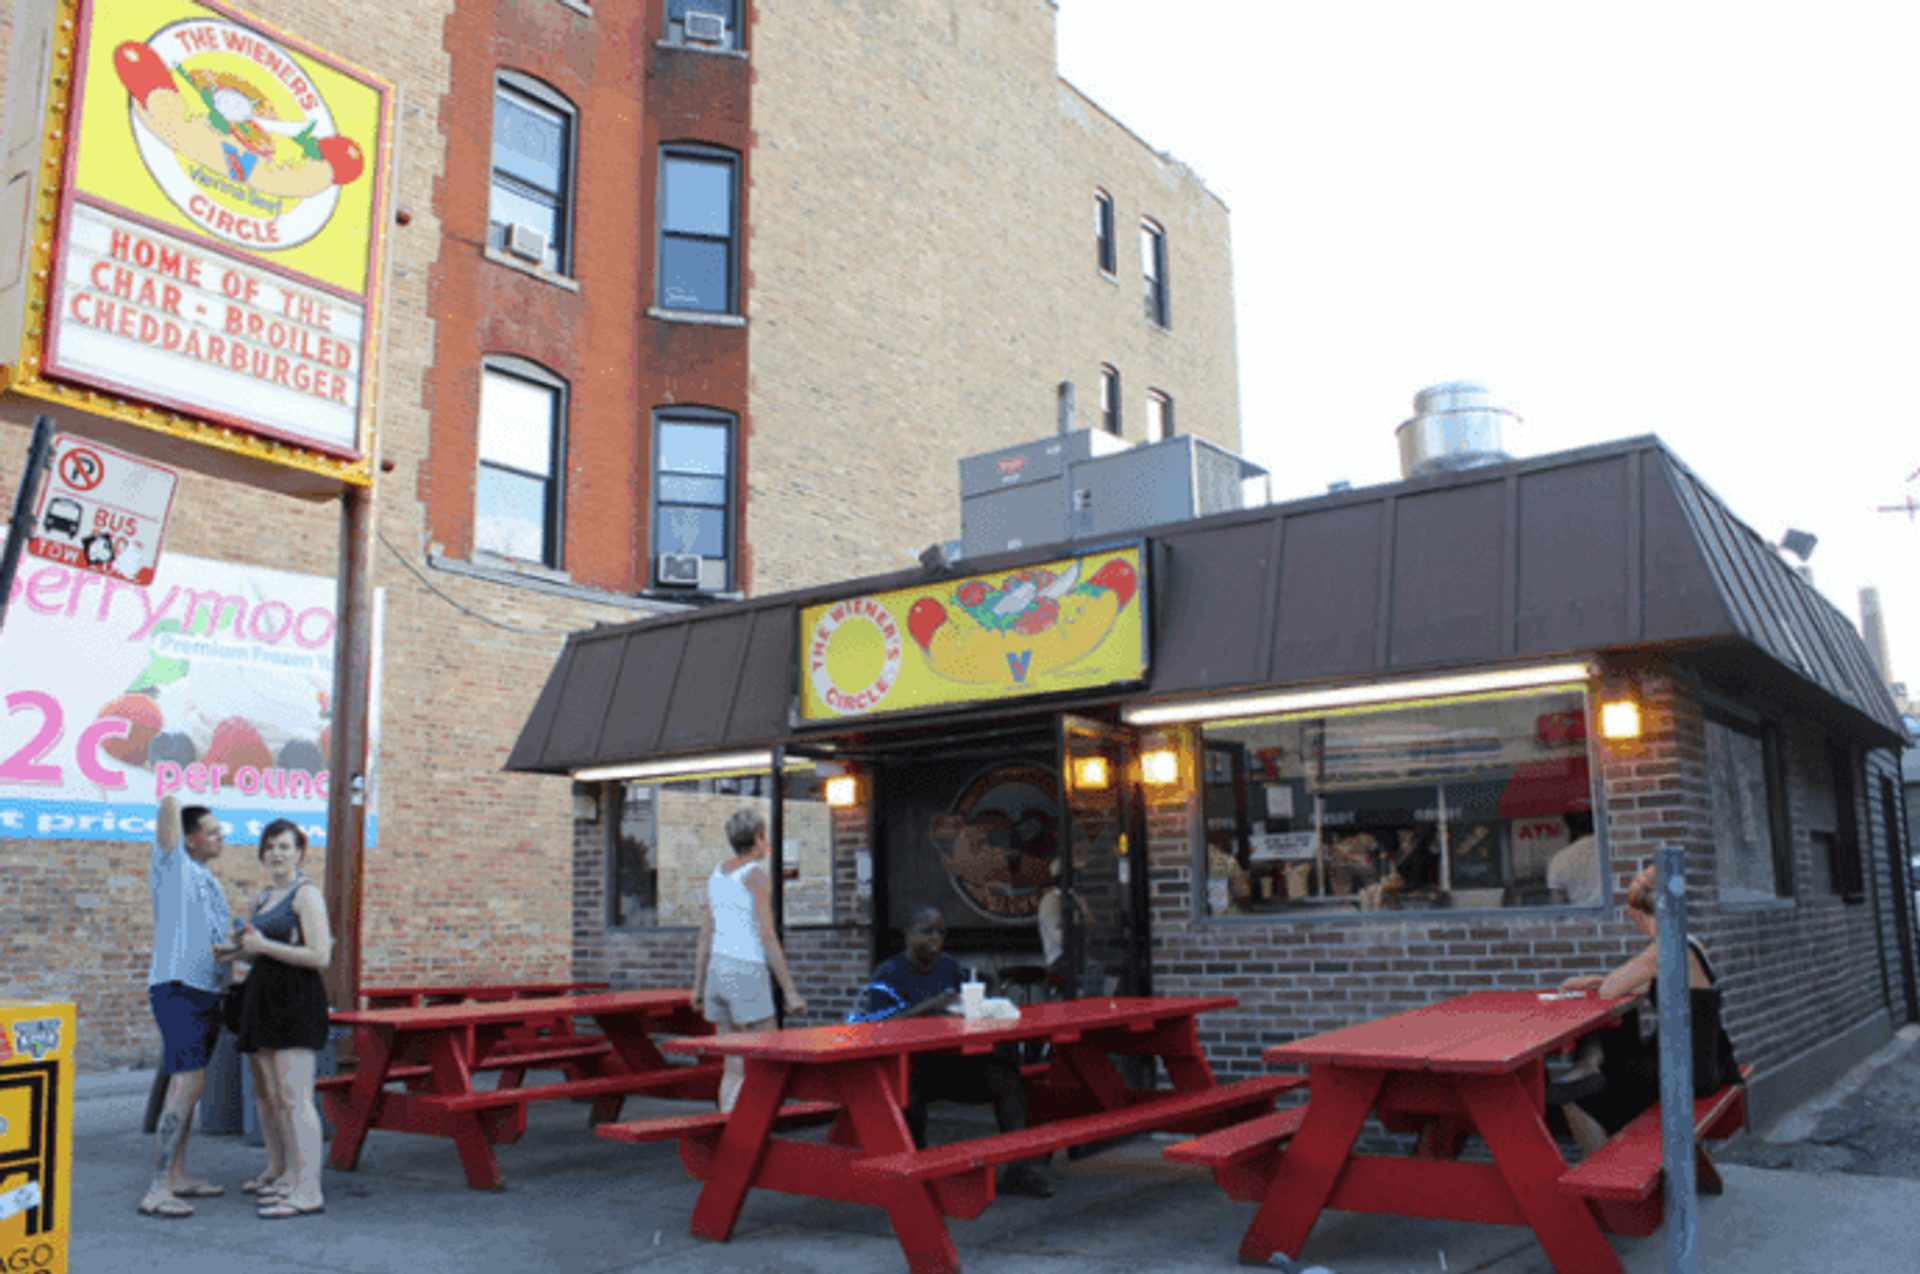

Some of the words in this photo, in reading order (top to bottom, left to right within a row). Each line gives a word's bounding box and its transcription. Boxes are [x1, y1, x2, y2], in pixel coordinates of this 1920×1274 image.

[175, 27, 219, 53] THE
[221, 29, 319, 111] WIENERS
[188, 194, 281, 243] CIRCLE
[110, 228, 202, 287] HOME
[222, 269, 259, 304] OF
[280, 288, 332, 332] THE
[91, 260, 182, 317] CHAR
[225, 305, 352, 370] BROILED
[70, 291, 347, 407] CHEDDARBURGER
[94, 508, 138, 536] BUS
[38, 542, 80, 563] TOW
[0, 546, 337, 649] errymoo
[160, 635, 249, 661] Premium
[252, 646, 313, 669] Frozen
[812, 626, 831, 672] THE
[826, 676, 889, 711] CIRCLE
[155, 761, 229, 798] per
[235, 766, 331, 798] ounc
